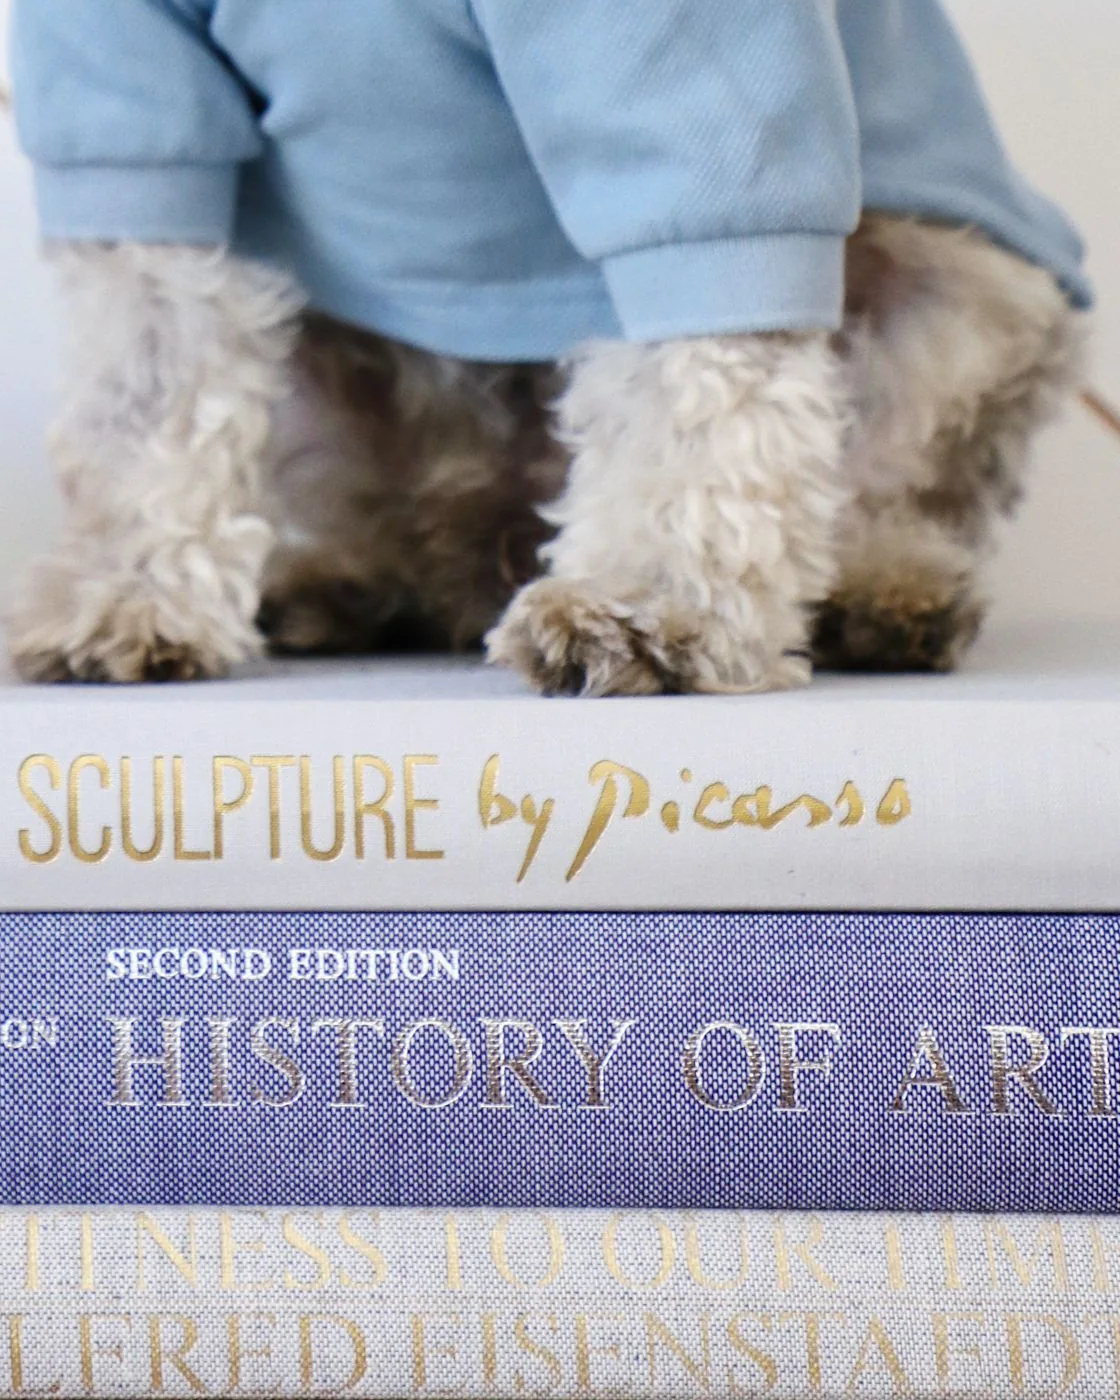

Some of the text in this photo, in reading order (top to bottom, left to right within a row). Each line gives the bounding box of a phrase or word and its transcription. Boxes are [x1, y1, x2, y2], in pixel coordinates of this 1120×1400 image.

[17, 752, 912, 884] SCULPTURE by Picasso
[106, 947, 461, 982] SECOND EDITION
[105, 1014, 1120, 1120] HISTORY OF ART
[428, 1211, 567, 1293] TO
[601, 1211, 843, 1293] OUR
